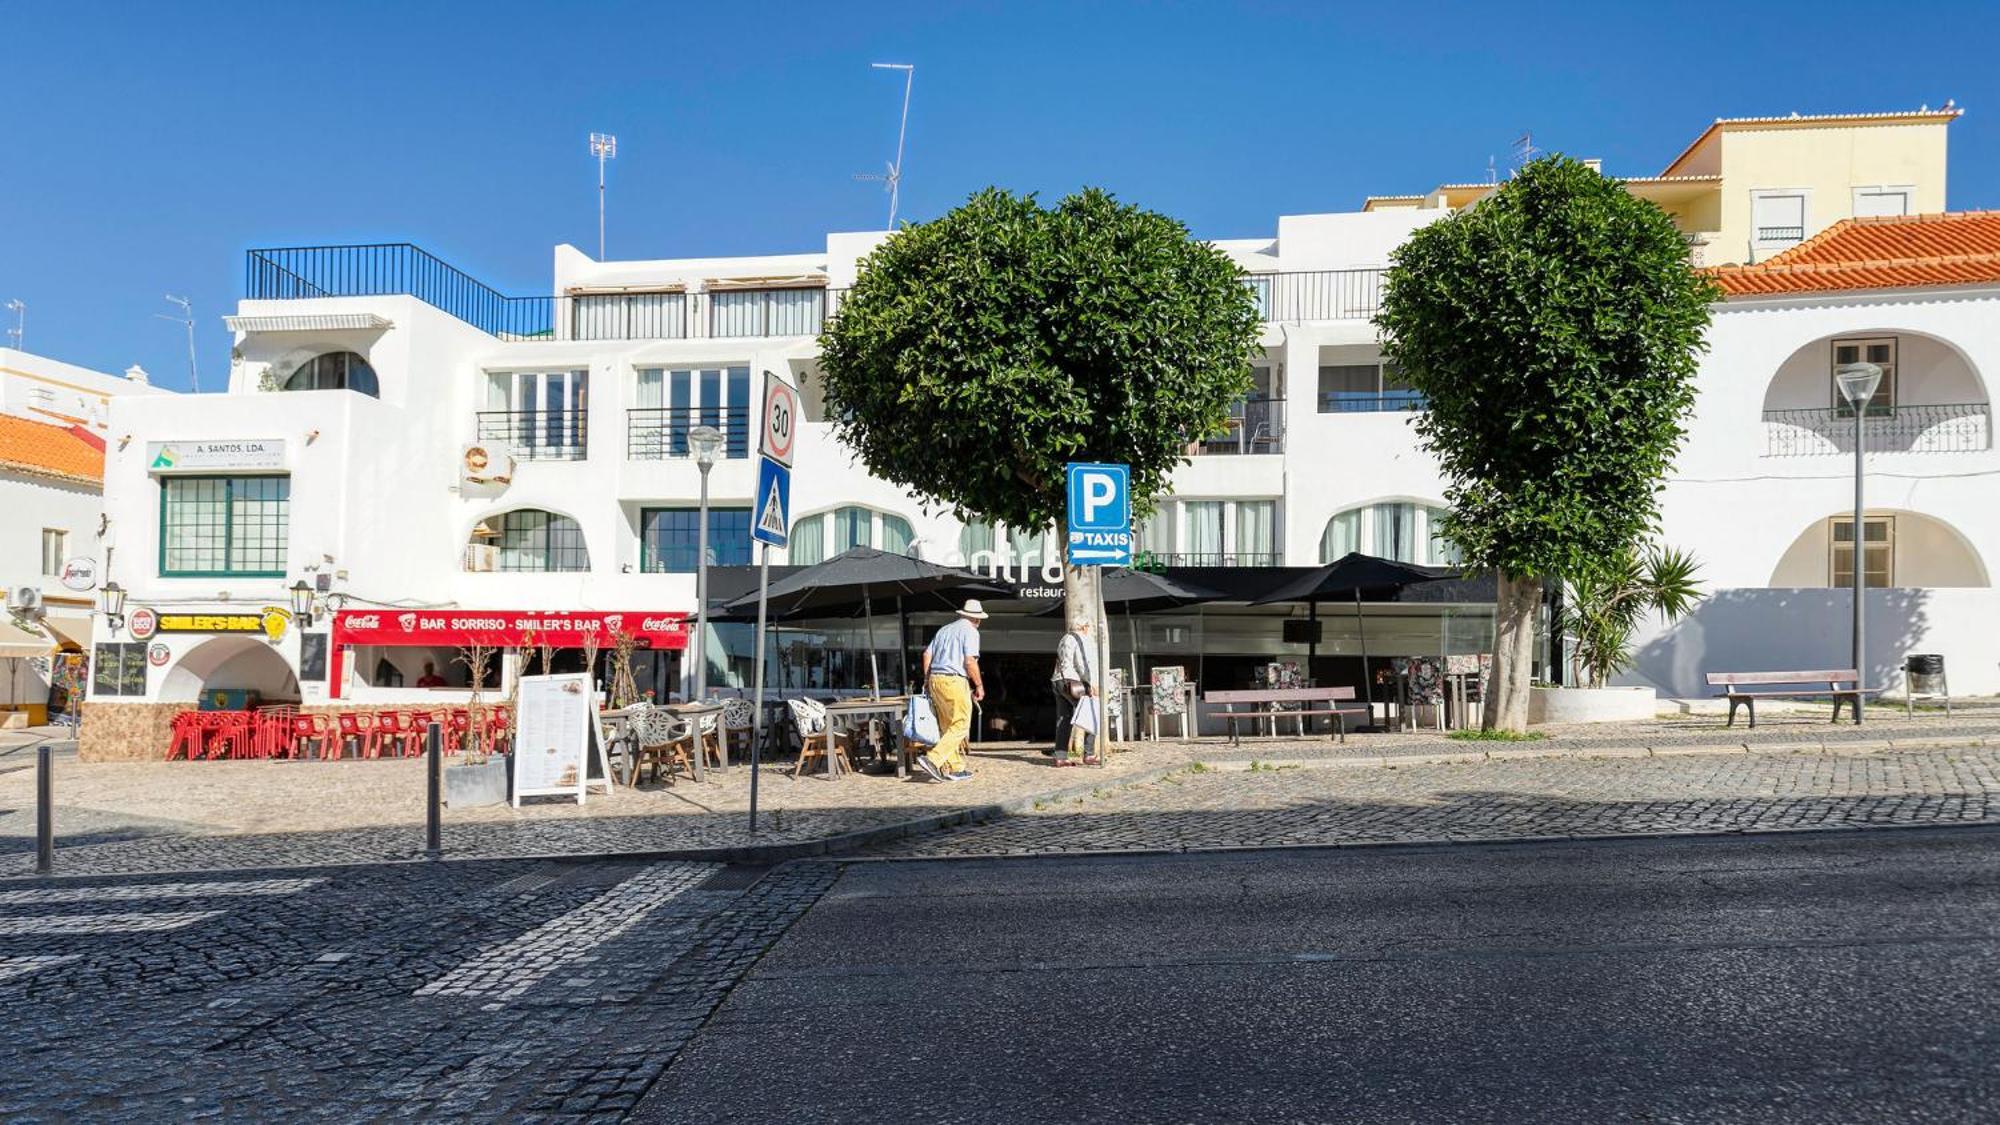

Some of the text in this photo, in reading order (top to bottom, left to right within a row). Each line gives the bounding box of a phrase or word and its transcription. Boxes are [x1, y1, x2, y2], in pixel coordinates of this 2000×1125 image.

[772, 403, 789, 438] 30
[246, 444, 264, 453] LDA
[1083, 473, 1117, 523] P
[1085, 532, 1129, 546] TAXIS
[420, 618, 446, 630] BAR
[451, 618, 506, 631] SORRISO
[515, 619, 572, 631] SMILER'S
[574, 619, 600, 631] BAR
